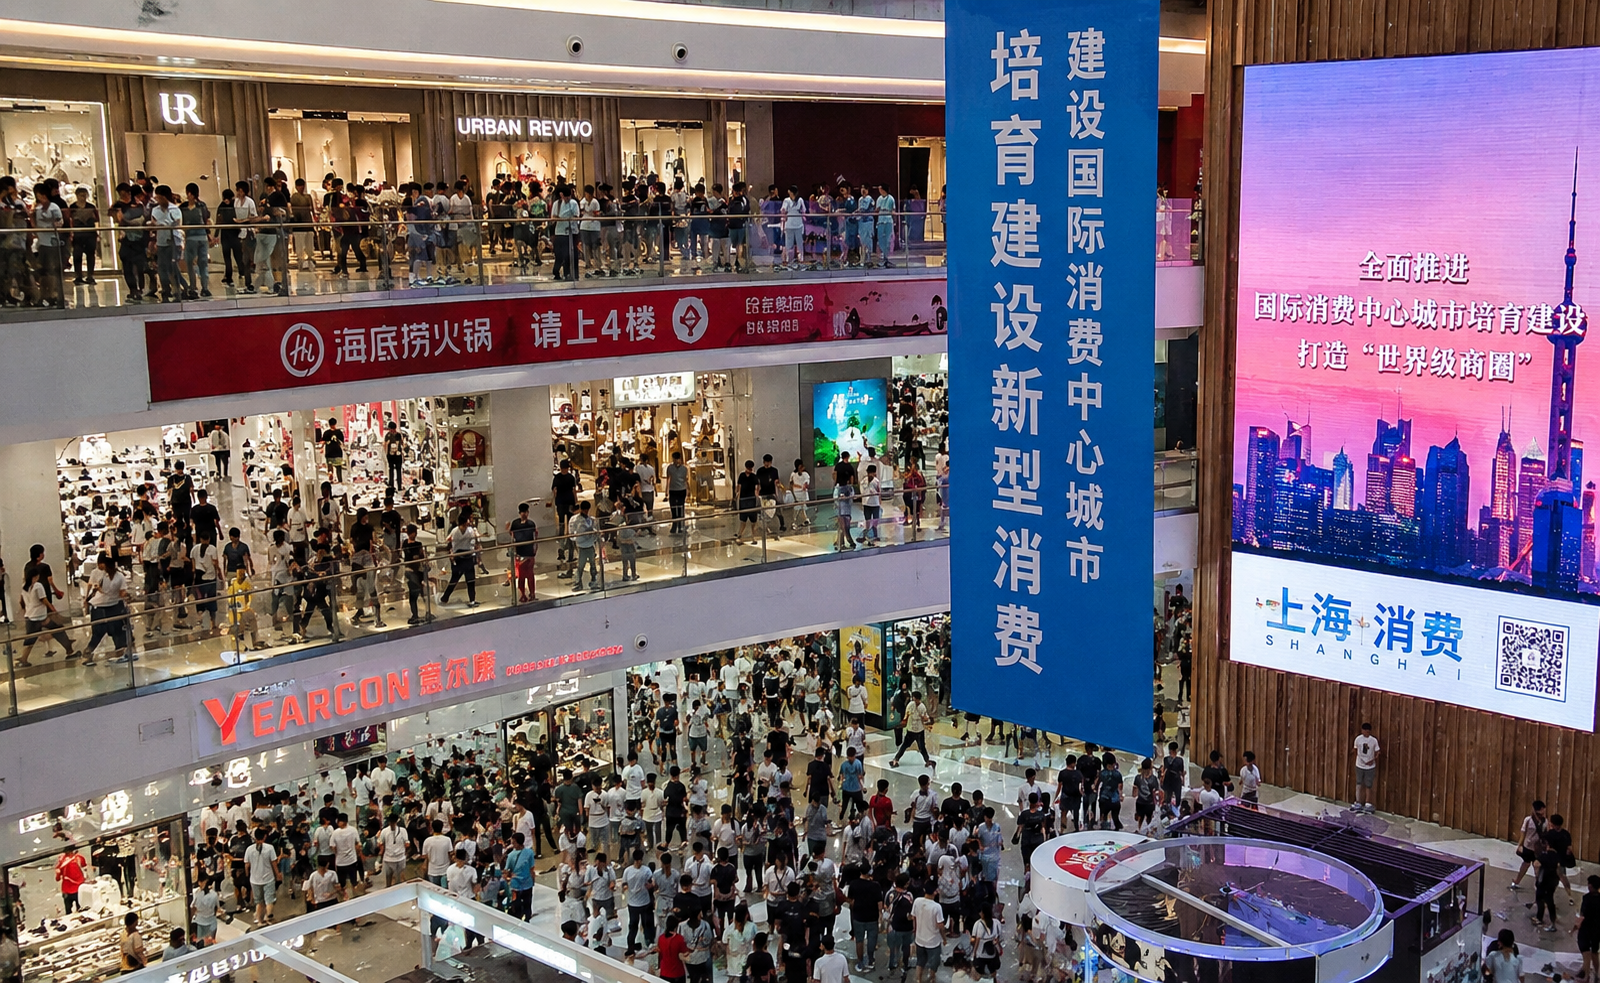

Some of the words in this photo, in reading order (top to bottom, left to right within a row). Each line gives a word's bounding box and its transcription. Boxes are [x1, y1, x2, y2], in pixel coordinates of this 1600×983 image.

[159, 93, 205, 126] UR
[457, 117, 522, 136] URBAN
[529, 119, 593, 138] REVIVO
[1358, 250, 1470, 284] 全面推进
[1065, 27, 1106, 584] 建设国际消费中心城市
[1254, 291, 1588, 336] 国际消费中心城市培育建设
[333, 317, 493, 366] 海底捞火锅
[530, 304, 656, 349] 请上4楼
[990, 28, 1044, 675] 培育建设新型消费
[202, 668, 411, 747] YEARCON
